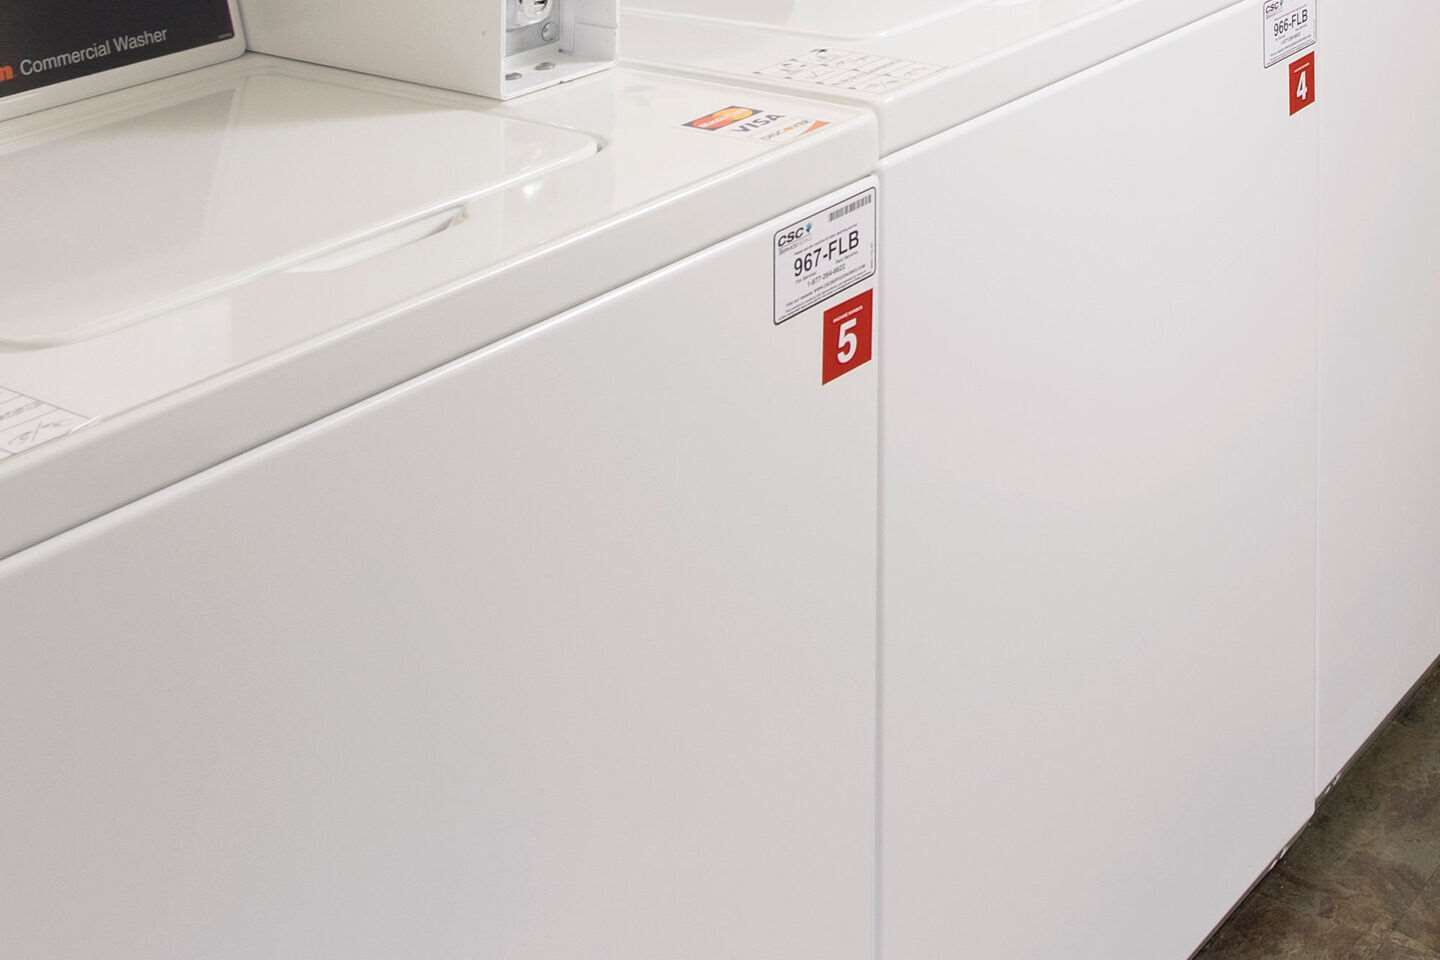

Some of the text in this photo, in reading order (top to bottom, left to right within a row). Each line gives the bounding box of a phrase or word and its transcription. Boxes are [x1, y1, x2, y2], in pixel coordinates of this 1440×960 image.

[1265, 2, 1279, 14] CSC
[1274, 8, 1309, 37] 966-FLB
[20, 29, 168, 76] Commercial Washer
[1296, 71, 1308, 101] 4
[778, 227, 804, 247] CSC
[794, 230, 859, 276] 967-FLB
[837, 317, 858, 364] 5
